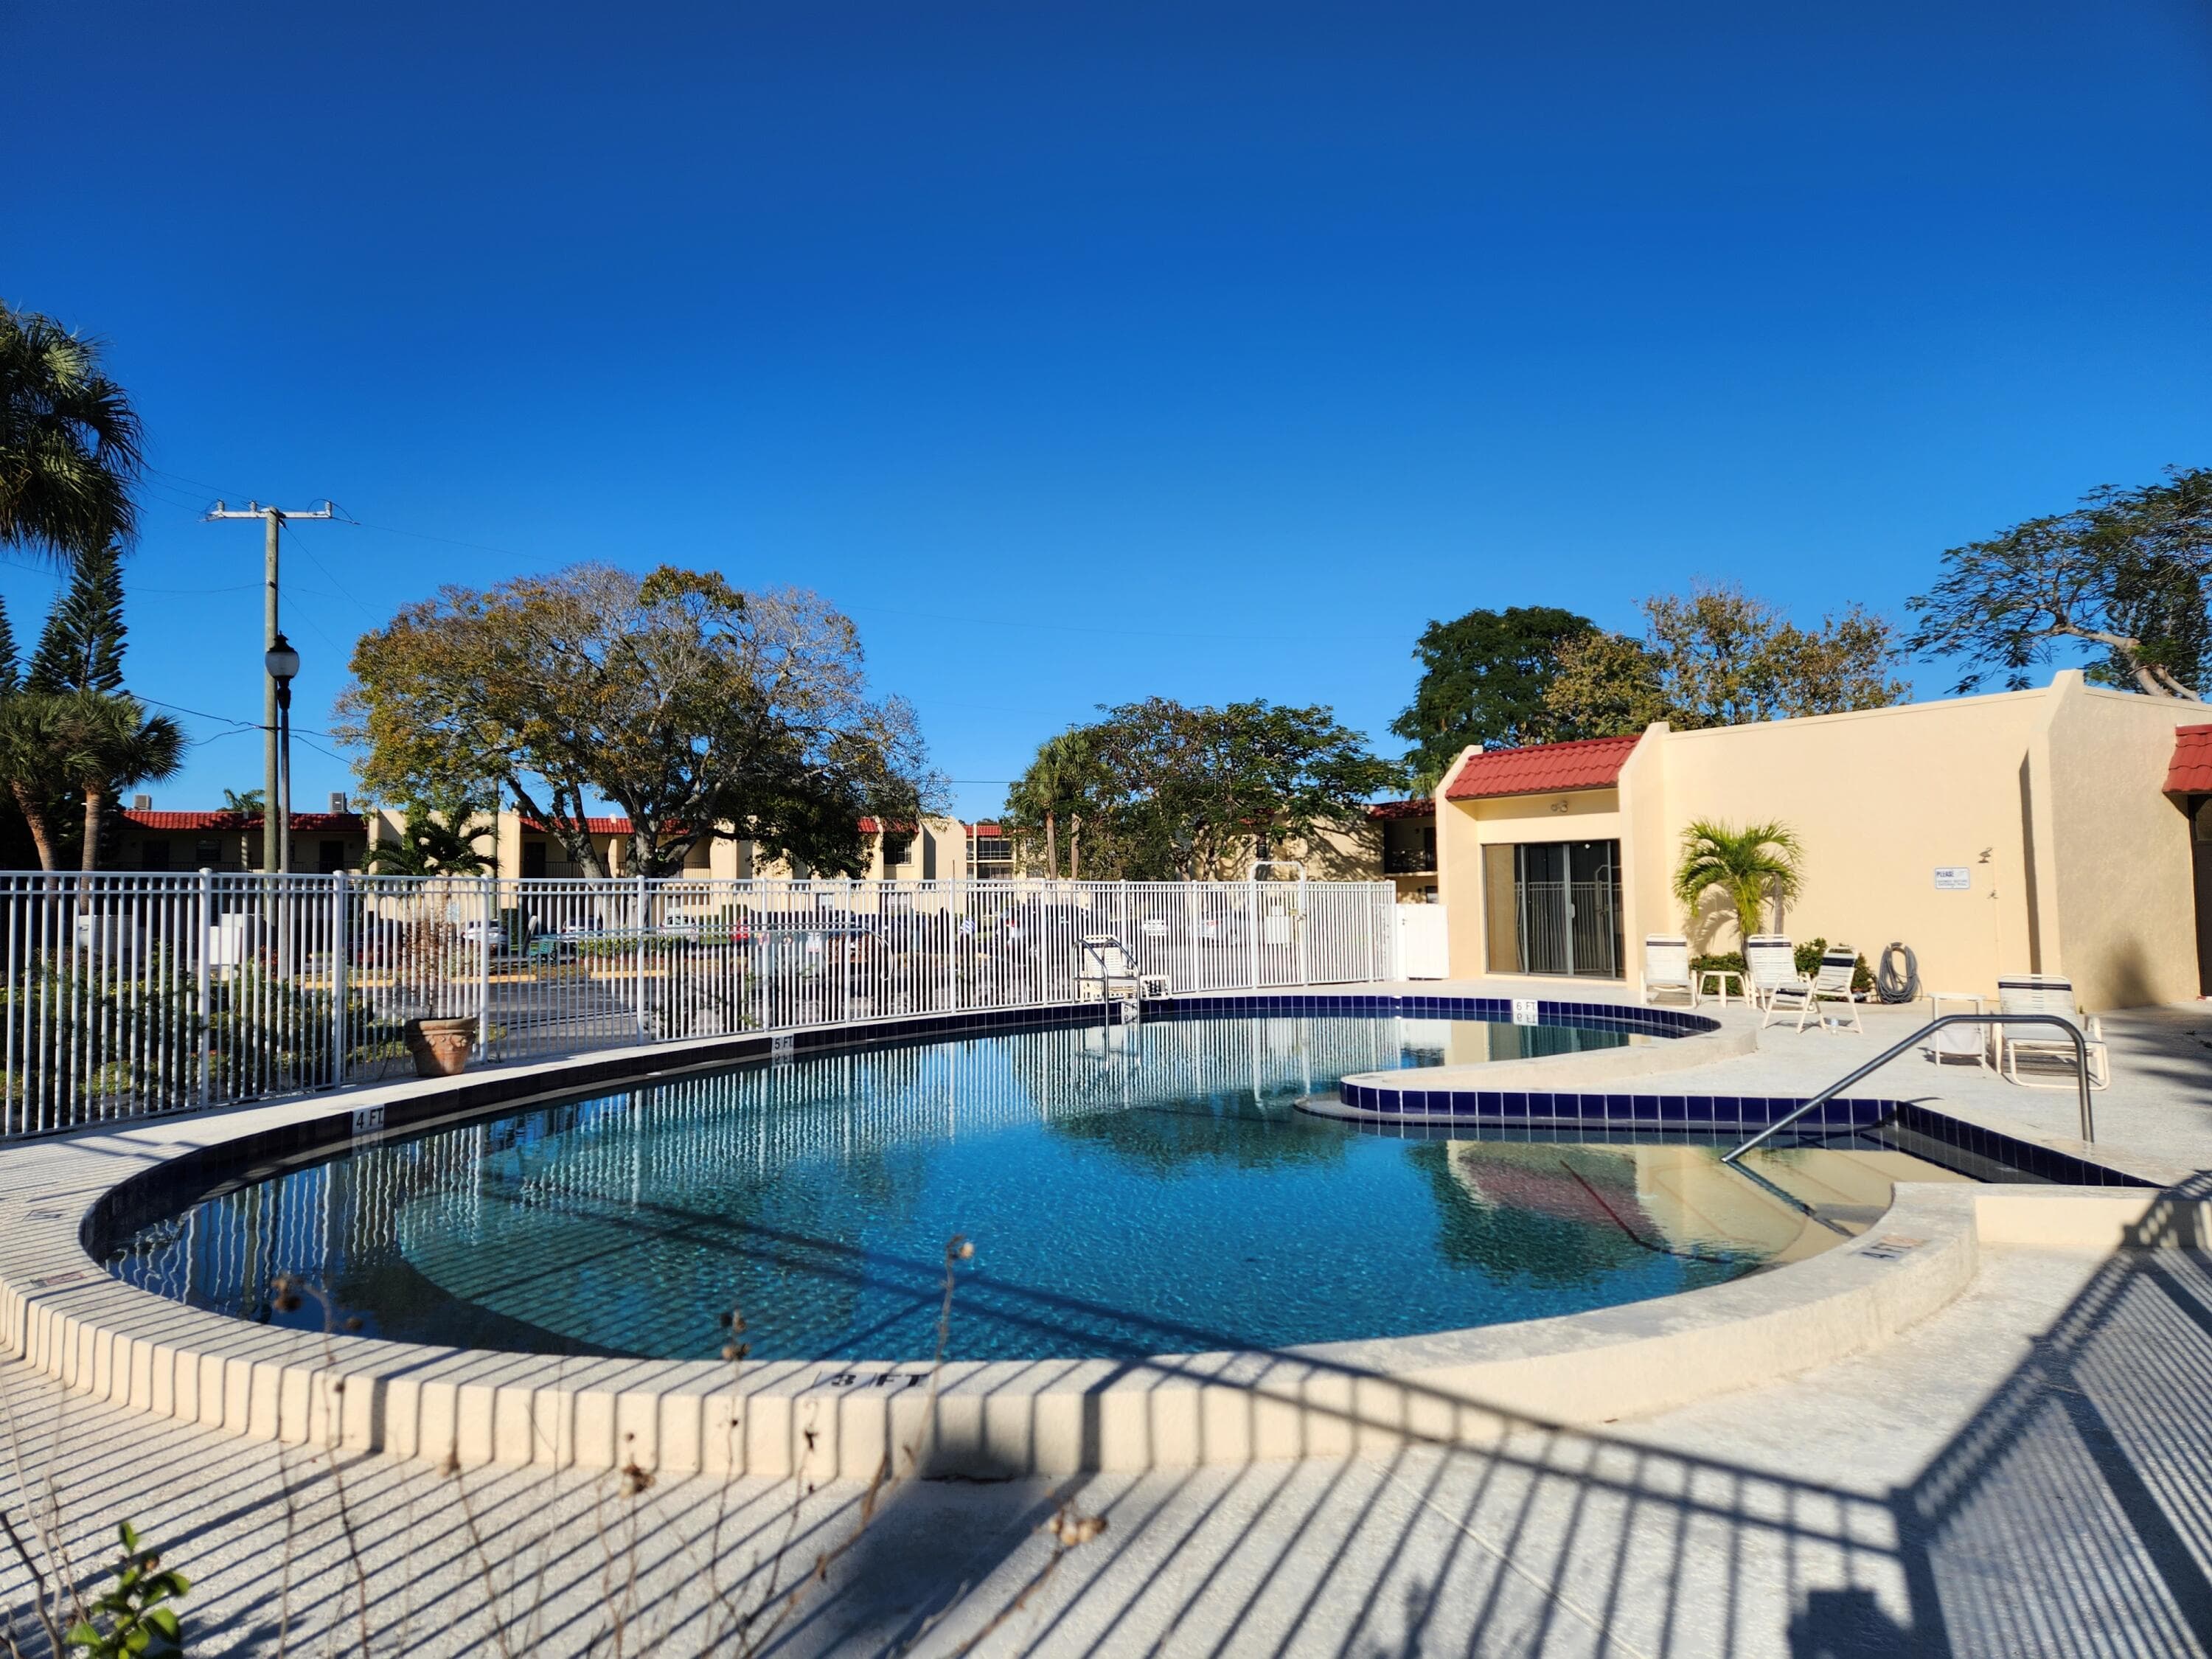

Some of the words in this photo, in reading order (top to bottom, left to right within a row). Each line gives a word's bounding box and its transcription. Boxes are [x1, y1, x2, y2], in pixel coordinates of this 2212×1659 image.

[1517, 1002, 1522, 1011] 6
[774, 1037, 780, 1050] 5
[356, 1112, 364, 1129] 4
[369, 1107, 383, 1127] FT.
[831, 1374, 857, 1387] 3
[875, 1374, 930, 1387] FT
